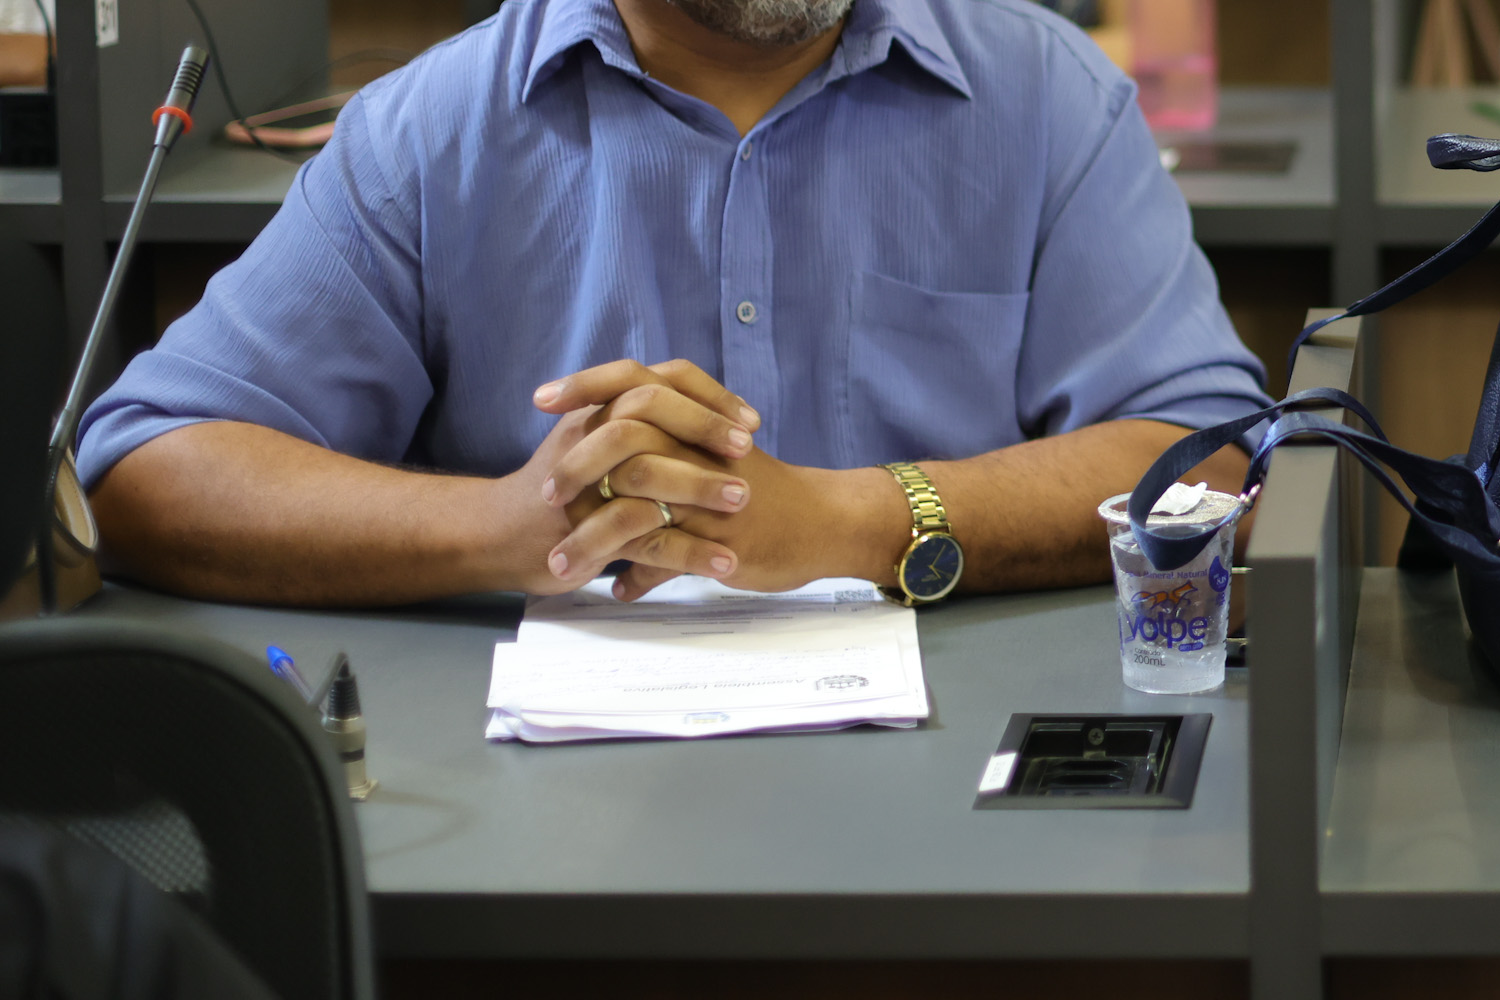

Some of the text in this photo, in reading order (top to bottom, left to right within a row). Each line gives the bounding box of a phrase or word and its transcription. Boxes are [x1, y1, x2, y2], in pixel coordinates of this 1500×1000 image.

[1177, 567, 1208, 580] Natural
[621, 677, 807, 694] Assembleia Legislativa
